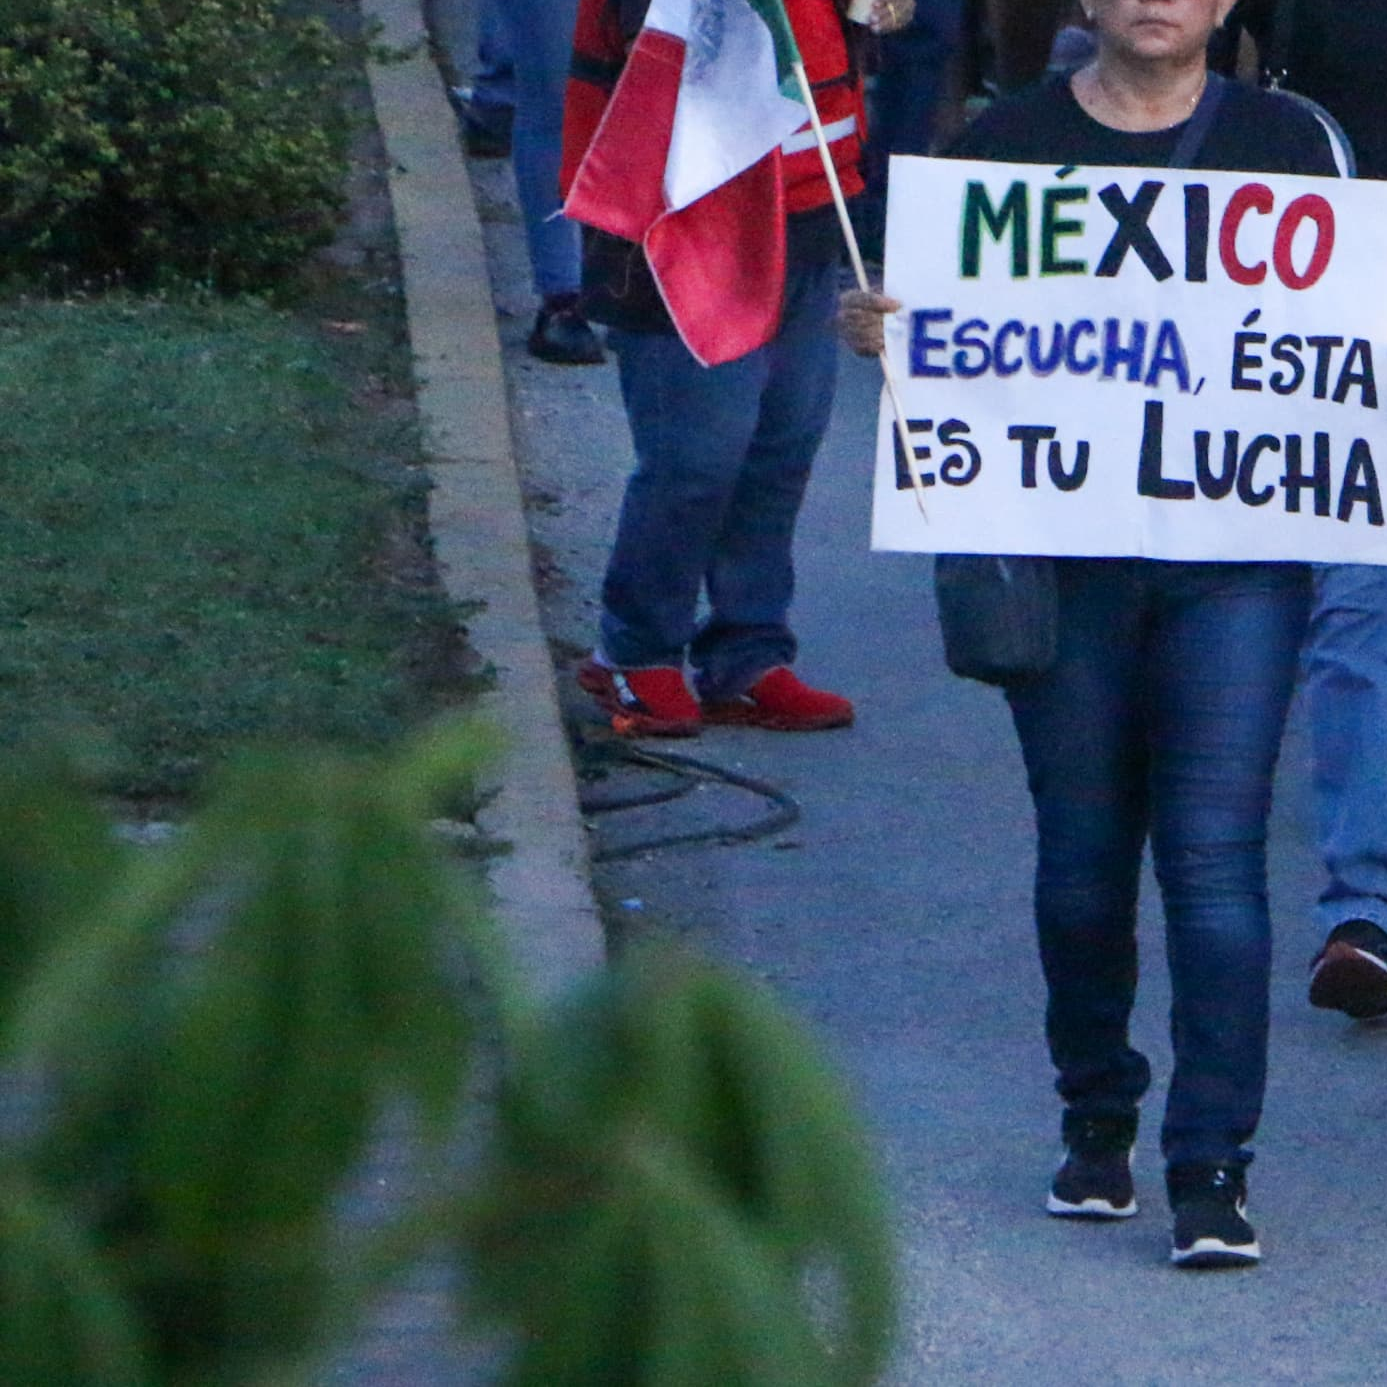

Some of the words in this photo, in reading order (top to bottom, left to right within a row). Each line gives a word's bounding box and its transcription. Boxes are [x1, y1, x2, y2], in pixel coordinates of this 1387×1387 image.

[958, 165, 1337, 290] MÉXICO
[1231, 308, 1379, 410] ÉSTA
[893, 417, 983, 491] ES
[1006, 425, 1090, 492] TU
[1136, 400, 1385, 527] LUCHA
